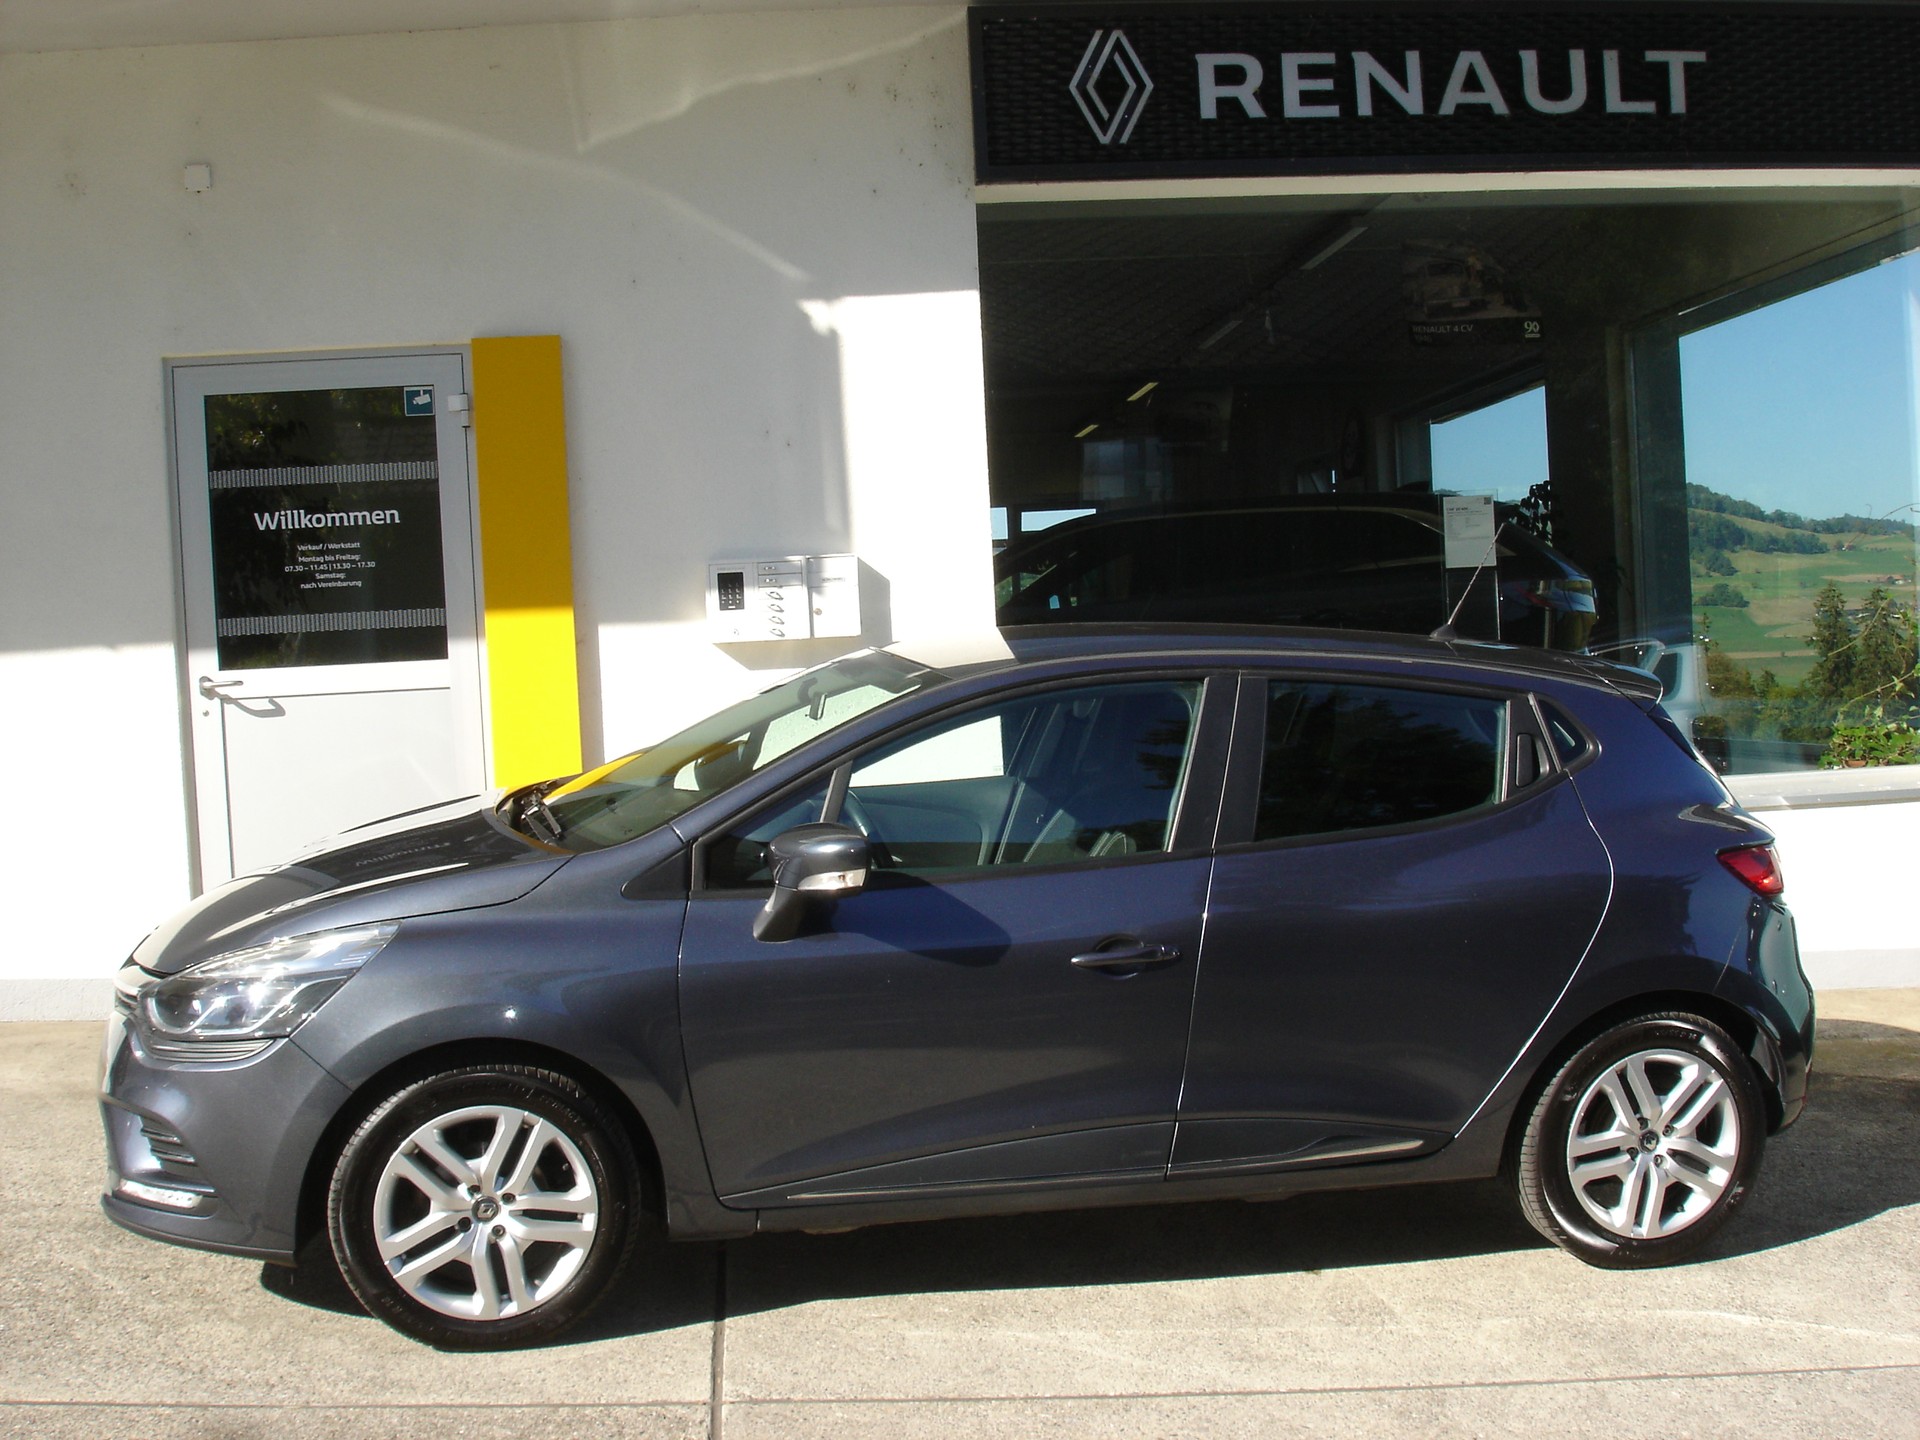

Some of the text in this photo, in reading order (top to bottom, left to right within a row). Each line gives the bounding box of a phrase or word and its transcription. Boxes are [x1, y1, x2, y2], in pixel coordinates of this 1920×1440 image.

[1195, 49, 1707, 120] RENAULT
[1452, 325, 1460, 333] 4
[1460, 324, 1474, 333] CV
[1524, 321, 1540, 333] 90
[254, 509, 400, 531] Willkommen
[327, 542, 360, 550] Werkstatt
[298, 555, 324, 563] Montag
[335, 554, 361, 562] Freitag:
[284, 565, 304, 573] 07.30
[310, 563, 328, 571] 11.45
[333, 562, 351, 570] 13.30
[357, 561, 376, 569] 17.30
[315, 572, 346, 580] Samstag:
[317, 580, 362, 588] Vereinbarung
